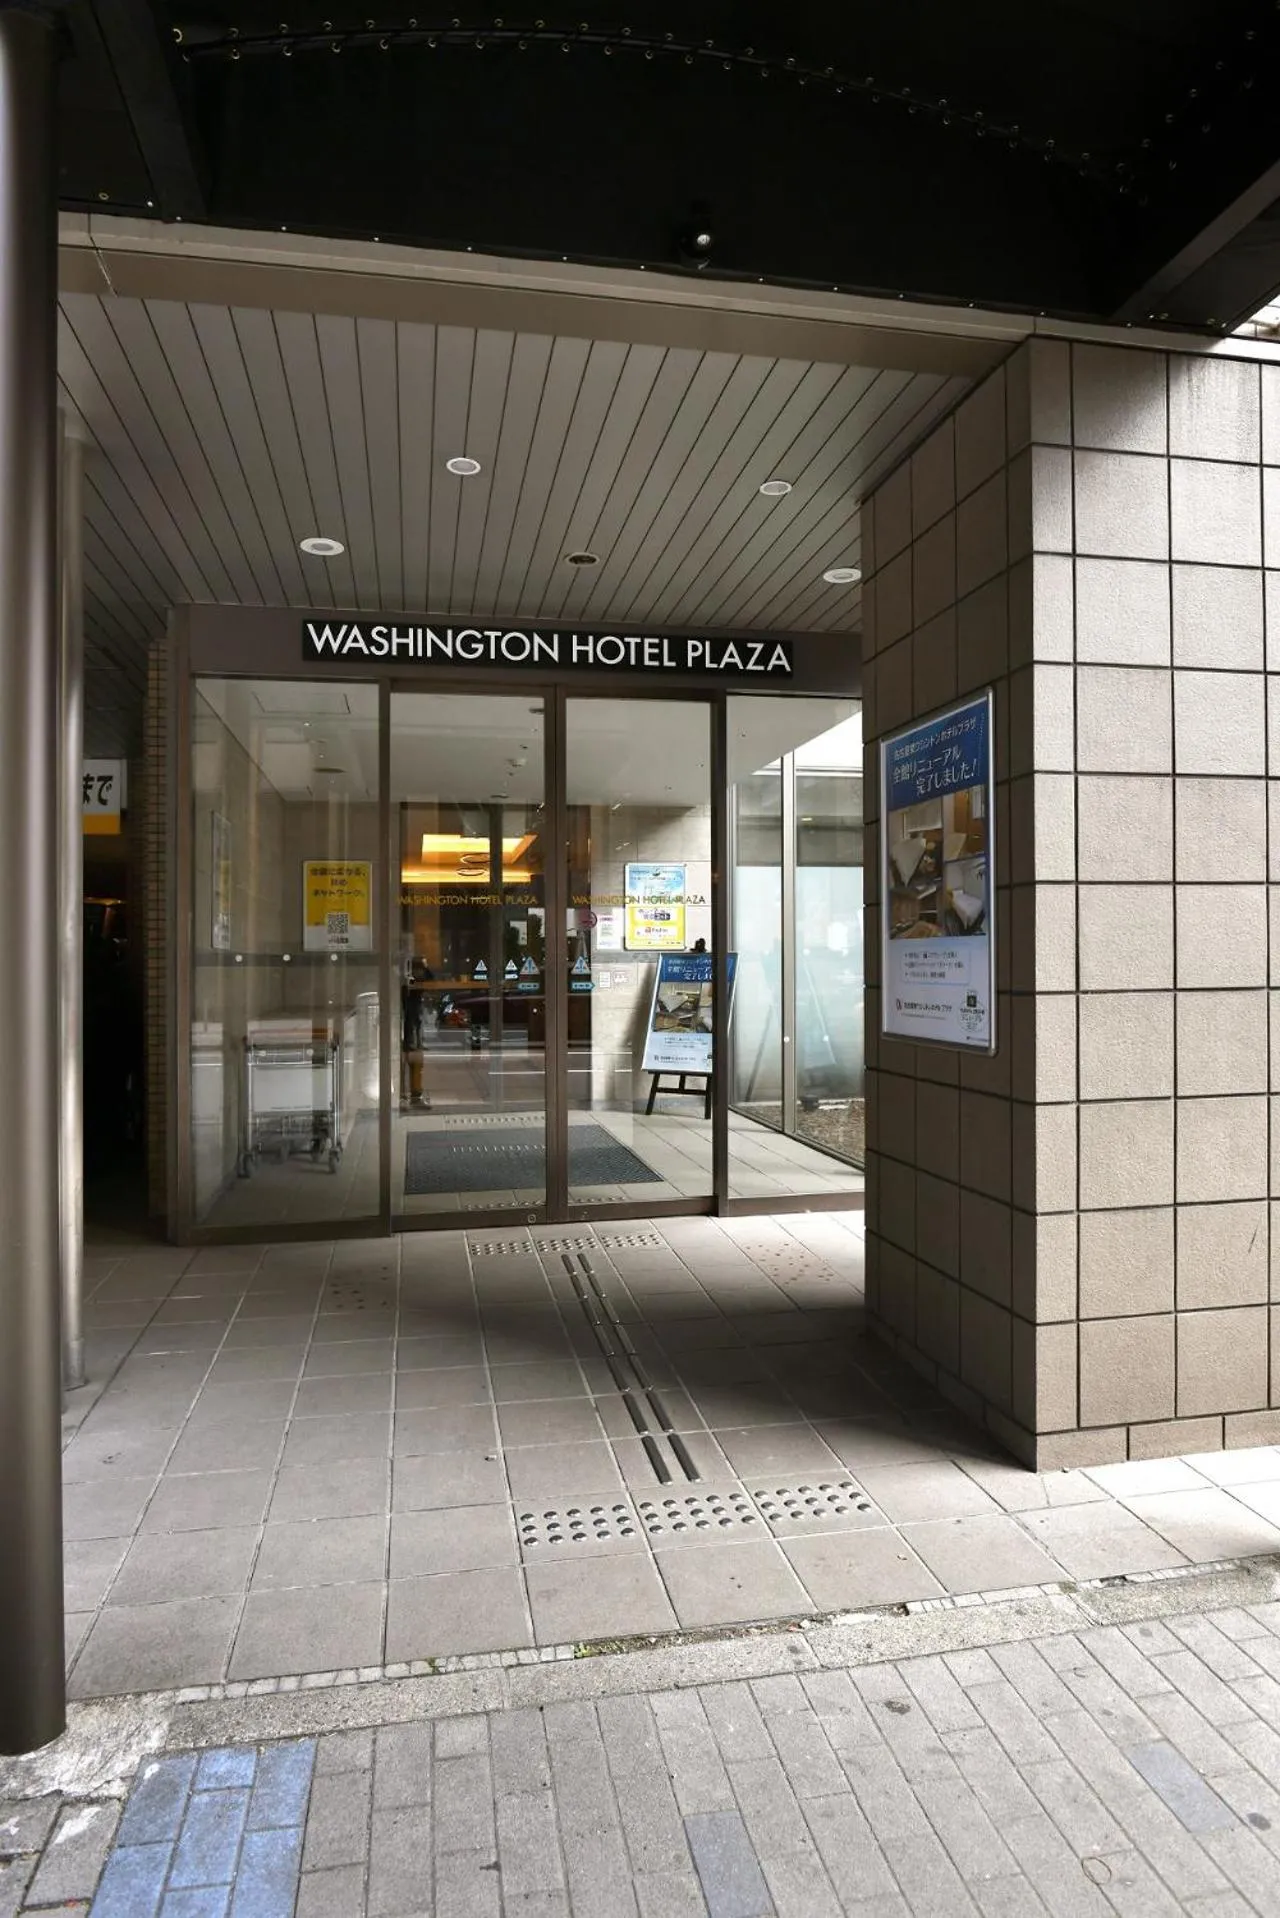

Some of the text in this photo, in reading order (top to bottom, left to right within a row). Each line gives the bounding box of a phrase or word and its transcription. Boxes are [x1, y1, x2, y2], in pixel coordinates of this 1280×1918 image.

[307, 622, 792, 673] WASHINGTON HOTEL PLAZA
[893, 744, 962, 785] 全館リニューアル
[398, 895, 538, 905] WASHINGTON HOTEL PLAZA
[572, 895, 640, 904] WASHINGTON
[642, 895, 672, 904] HOTEL
